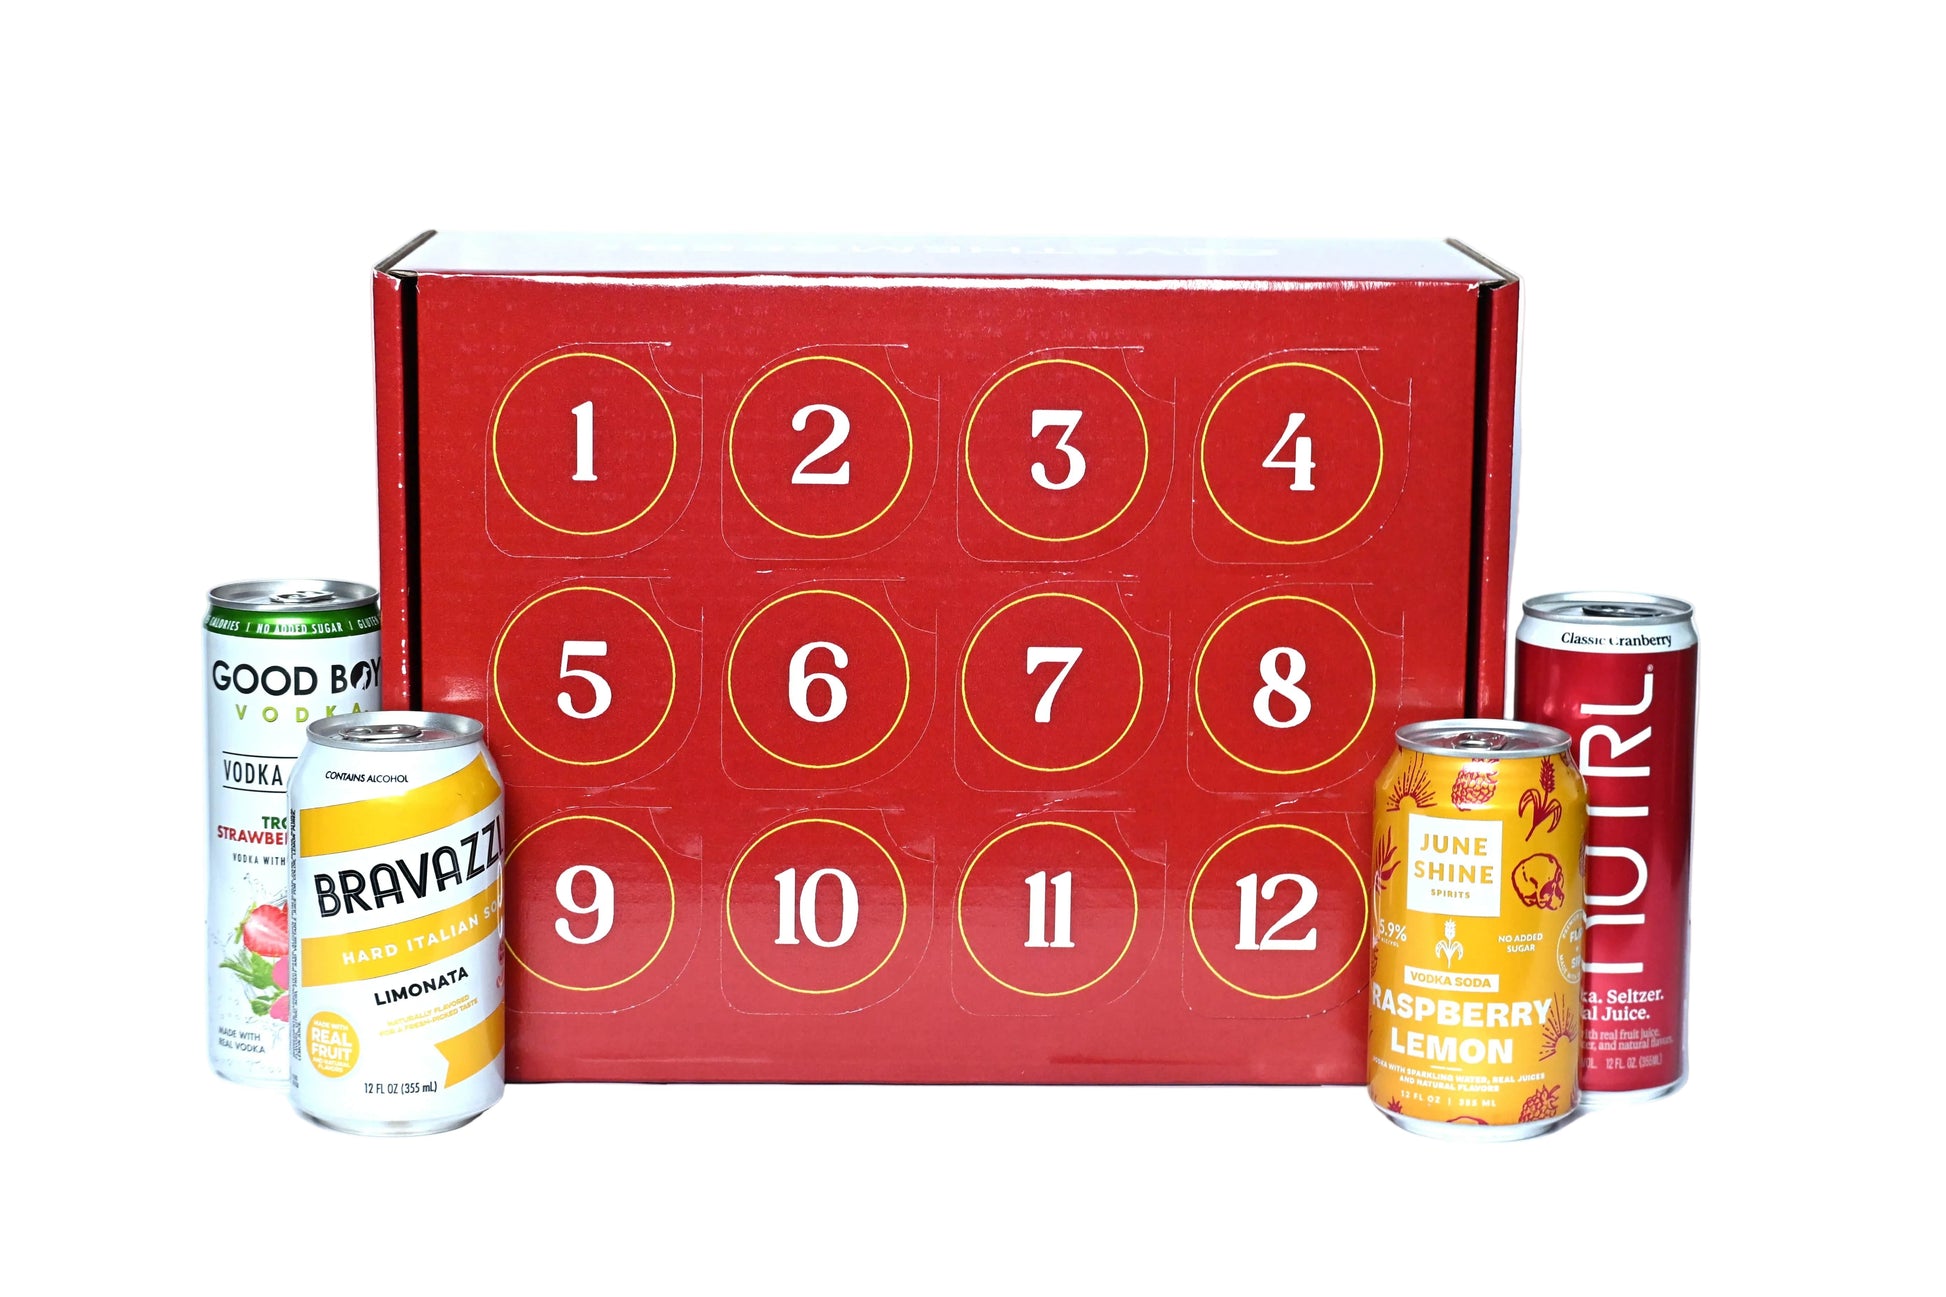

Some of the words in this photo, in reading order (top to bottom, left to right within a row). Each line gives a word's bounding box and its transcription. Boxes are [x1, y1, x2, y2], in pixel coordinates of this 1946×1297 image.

[572, 401, 597, 482] 1
[791, 403, 851, 485] 2
[1030, 409, 1087, 491] 3
[1261, 412, 1317, 492] 4
[209, 616, 240, 631] CALORIES
[256, 624, 269, 634] NO
[274, 624, 308, 635] ADDED
[312, 622, 343, 634] SUGAR
[212, 659, 318, 696] GOOD
[557, 640, 611, 720] 5
[788, 640, 849, 723] 6
[1026, 647, 1084, 723] 7
[1252, 647, 1312, 728] 8
[223, 759, 283, 786] VODKA
[325, 770, 366, 783] CONTAINS
[366, 774, 408, 784] ALCOHOL
[217, 825, 287, 845] STRAWBE
[1420, 833, 1488, 856] JUNE
[233, 853, 259, 865] VODKA
[263, 856, 286, 866] WITH
[1414, 860, 1494, 884] SHINE
[1430, 888, 1471, 899] SPIRITS
[554, 864, 615, 945] 9
[773, 867, 860, 949] 10
[1023, 871, 1076, 949] 11
[1234, 872, 1319, 951] 12
[342, 943, 399, 966] HARD
[407, 914, 479, 952] ITALIAN
[1498, 934, 1512, 943] NO
[1514, 932, 1544, 943] ADDED
[1507, 943, 1536, 953] SUGAR
[373, 966, 469, 1006] LIMONATA
[1410, 970, 1452, 986] VODKA
[1455, 976, 1492, 988] SODA
[459, 998, 478, 1011] TASTE
[1371, 981, 1553, 1028] RASPBERRY
[1607, 988, 1664, 1004] Seltzer.
[387, 1009, 432, 1026] NATURALLY
[434, 994, 470, 1013] FLAVORED
[1601, 1006, 1651, 1021] Juice.
[219, 1026, 237, 1038] MADE
[240, 1031, 261, 1042] WITH
[312, 1027, 353, 1048] REAL
[331, 1023, 349, 1031] WITH
[1600, 1029, 1618, 1040] real
[1620, 1028, 1640, 1040] fruit
[235, 1041, 265, 1054] VODKA
[312, 1043, 353, 1061] FRUIT
[1391, 1027, 1514, 1064] LEMON
[1598, 1040, 1616, 1050] and
[1618, 1038, 1649, 1050] natural
[1388, 1063, 1406, 1073] WITH
[1407, 1068, 1454, 1083] SPARKLING
[1455, 1075, 1491, 1085] WATER,
[1492, 1075, 1515, 1084] REAL
[1517, 1072, 1546, 1083] JUICES
[1606, 1057, 1613, 1070] 12
[364, 1082, 374, 1094] 12
[376, 1083, 385, 1094] FL
[387, 1083, 399, 1094] OZ
[401, 1082, 420, 1095] (355
[422, 1081, 438, 1093] mL)
[1399, 1075, 1415, 1085] AND
[1416, 1079, 1456, 1091] NATURAL
[1457, 1083, 1500, 1092] FLAVORS
[1401, 1090, 1411, 1099] 12
[1413, 1092, 1423, 1101] FL
[1427, 1095, 1441, 1104] OZ
[1481, 1099, 1497, 1108] ML
